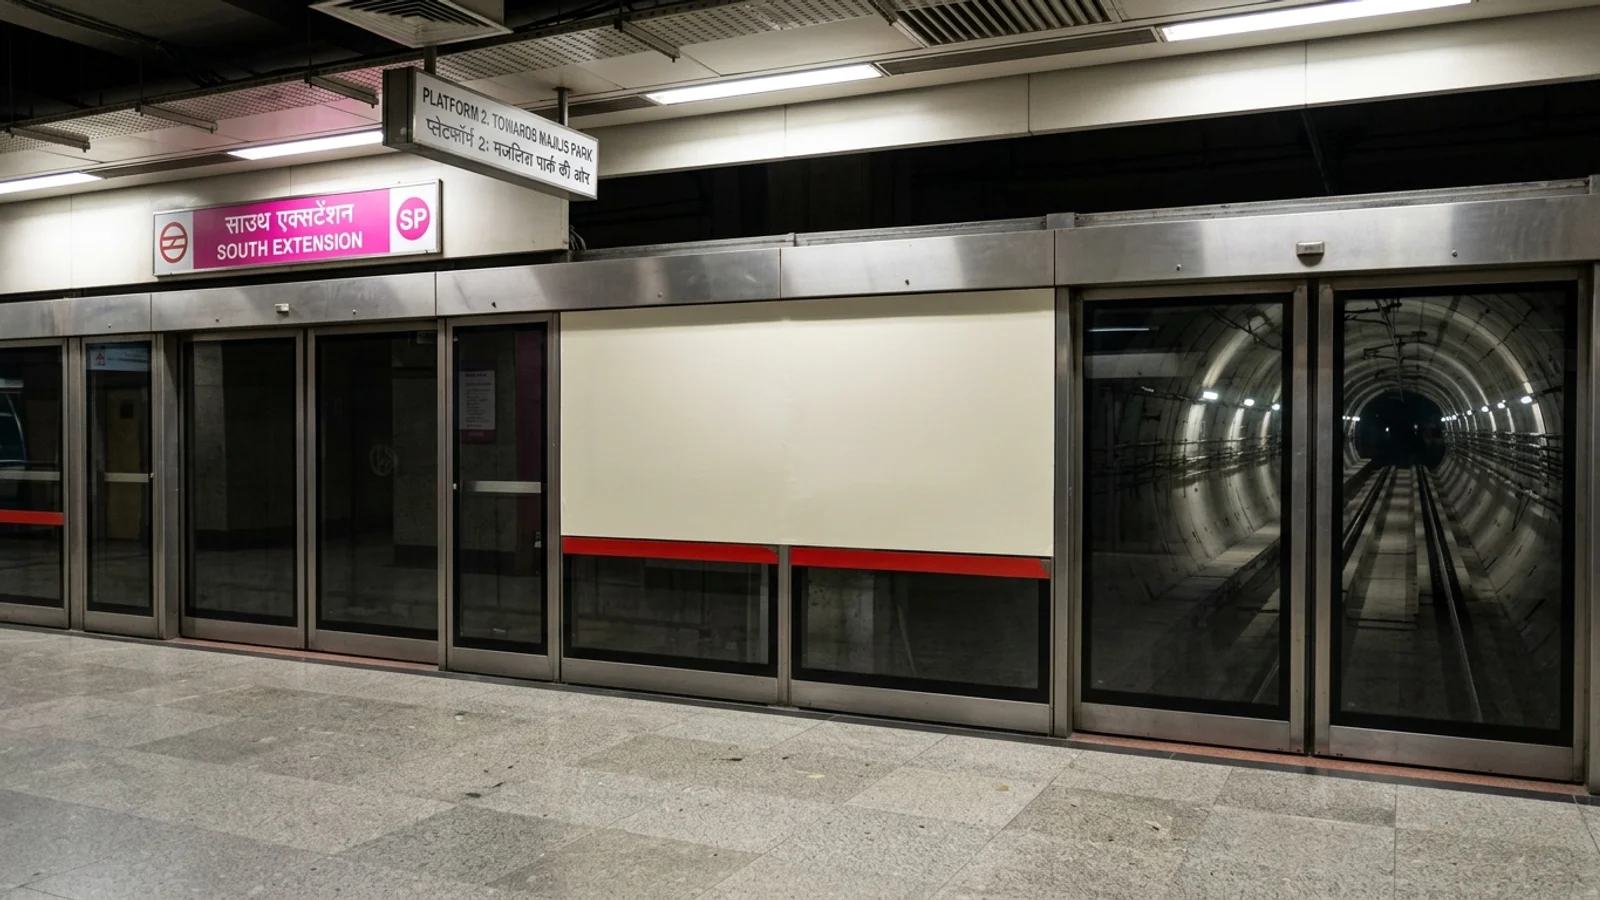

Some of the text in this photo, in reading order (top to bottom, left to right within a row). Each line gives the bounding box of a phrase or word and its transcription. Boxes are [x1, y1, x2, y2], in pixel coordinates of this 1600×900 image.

[422, 86, 479, 122] PLATFORM
[570, 142, 593, 162] PARK
[225, 200, 355, 235] साउथ एक्सटेंशन
[399, 207, 427, 231] SP
[216, 231, 363, 261] SOUTH EXTENSION
